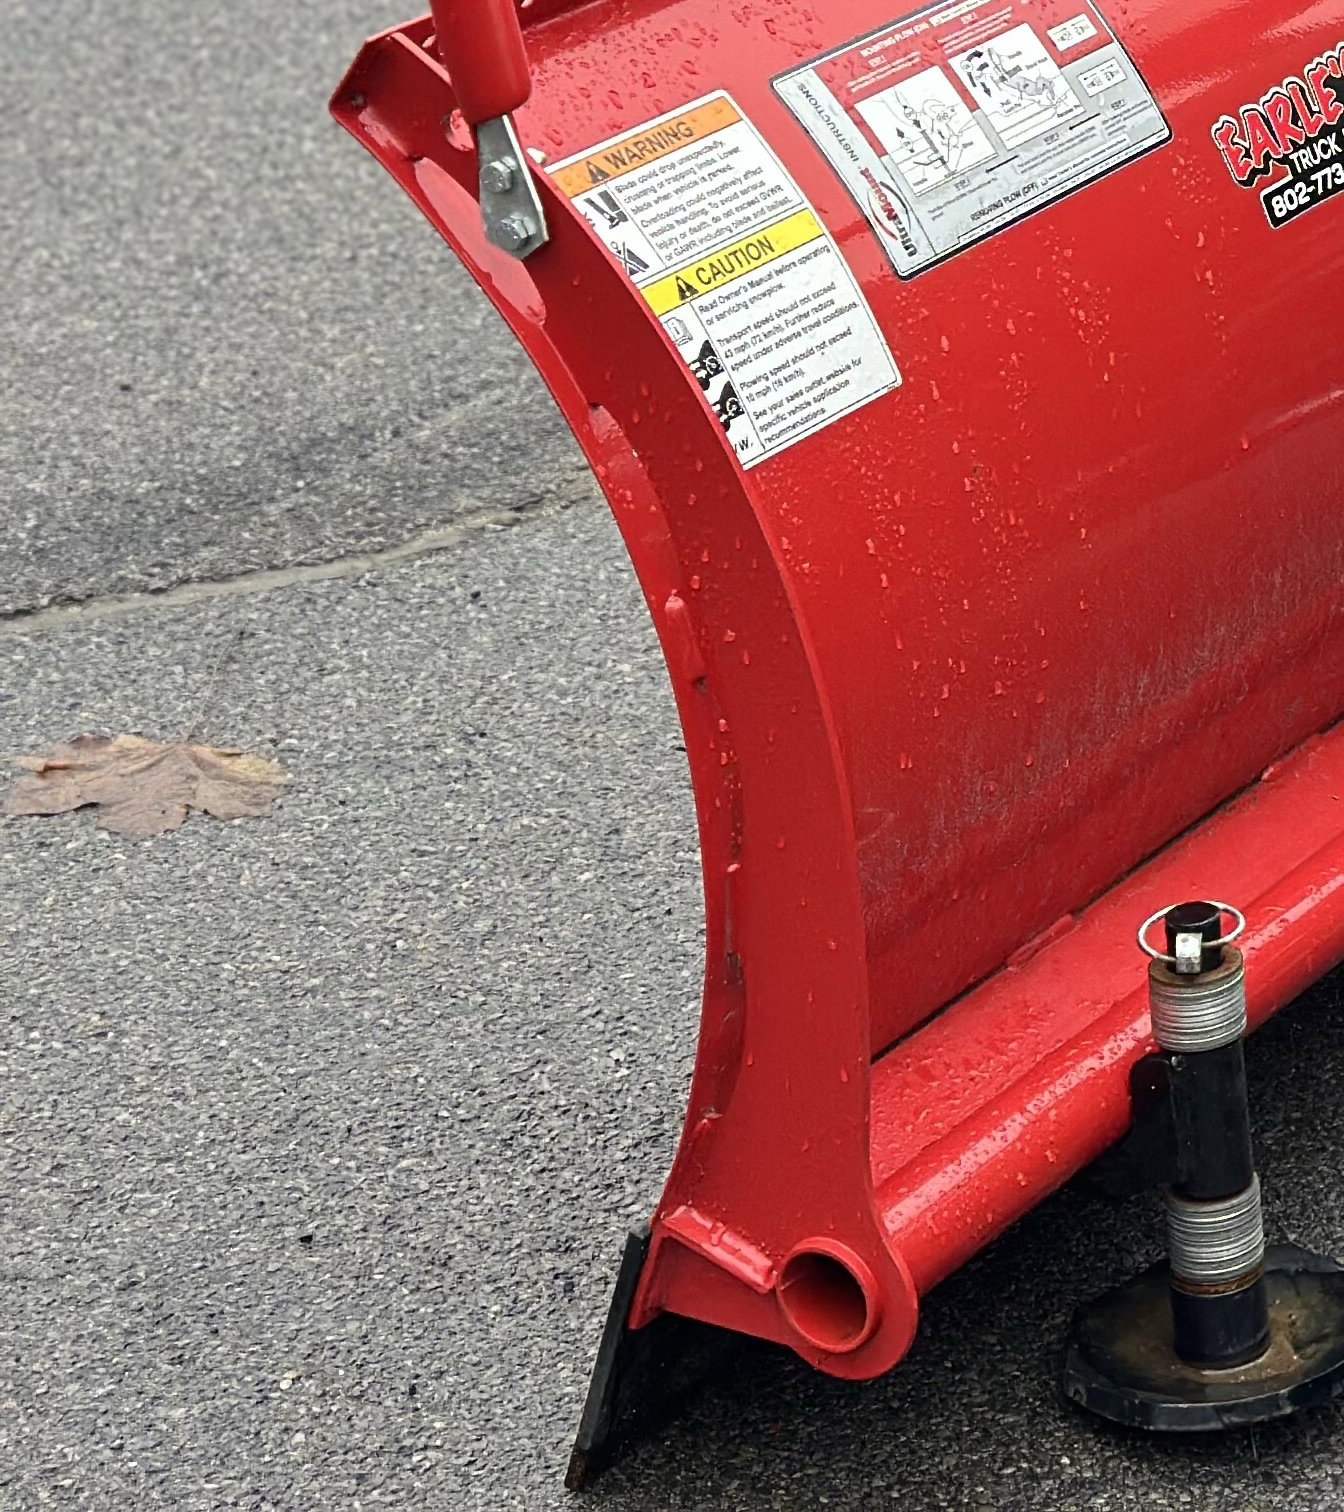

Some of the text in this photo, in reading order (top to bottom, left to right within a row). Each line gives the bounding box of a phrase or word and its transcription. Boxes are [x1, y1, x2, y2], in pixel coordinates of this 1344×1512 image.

[602, 120, 694, 171] WARNING
[797, 82, 860, 164] INSTRUCTIONS
[1288, 133, 1342, 172] TRUCK
[758, 184, 784, 201] GVWR
[694, 234, 776, 286] CAUTION
[697, 243, 831, 314] Read Owner's Manual before operating
[705, 316, 715, 326] or
[714, 299, 750, 322] servicing
[716, 281, 837, 348] Transport speed should not exceed
[783, 309, 811, 328] Further
[810, 298, 836, 315] reduce
[729, 353, 754, 373] speed
[752, 344, 774, 361] under
[773, 330, 803, 349] adverse
[800, 317, 822, 335] travel
[738, 325, 853, 392] Plowing speed should not exceed
[752, 408, 768, 421] See
[767, 398, 785, 415] your
[758, 378, 851, 433] specific vehicle application
